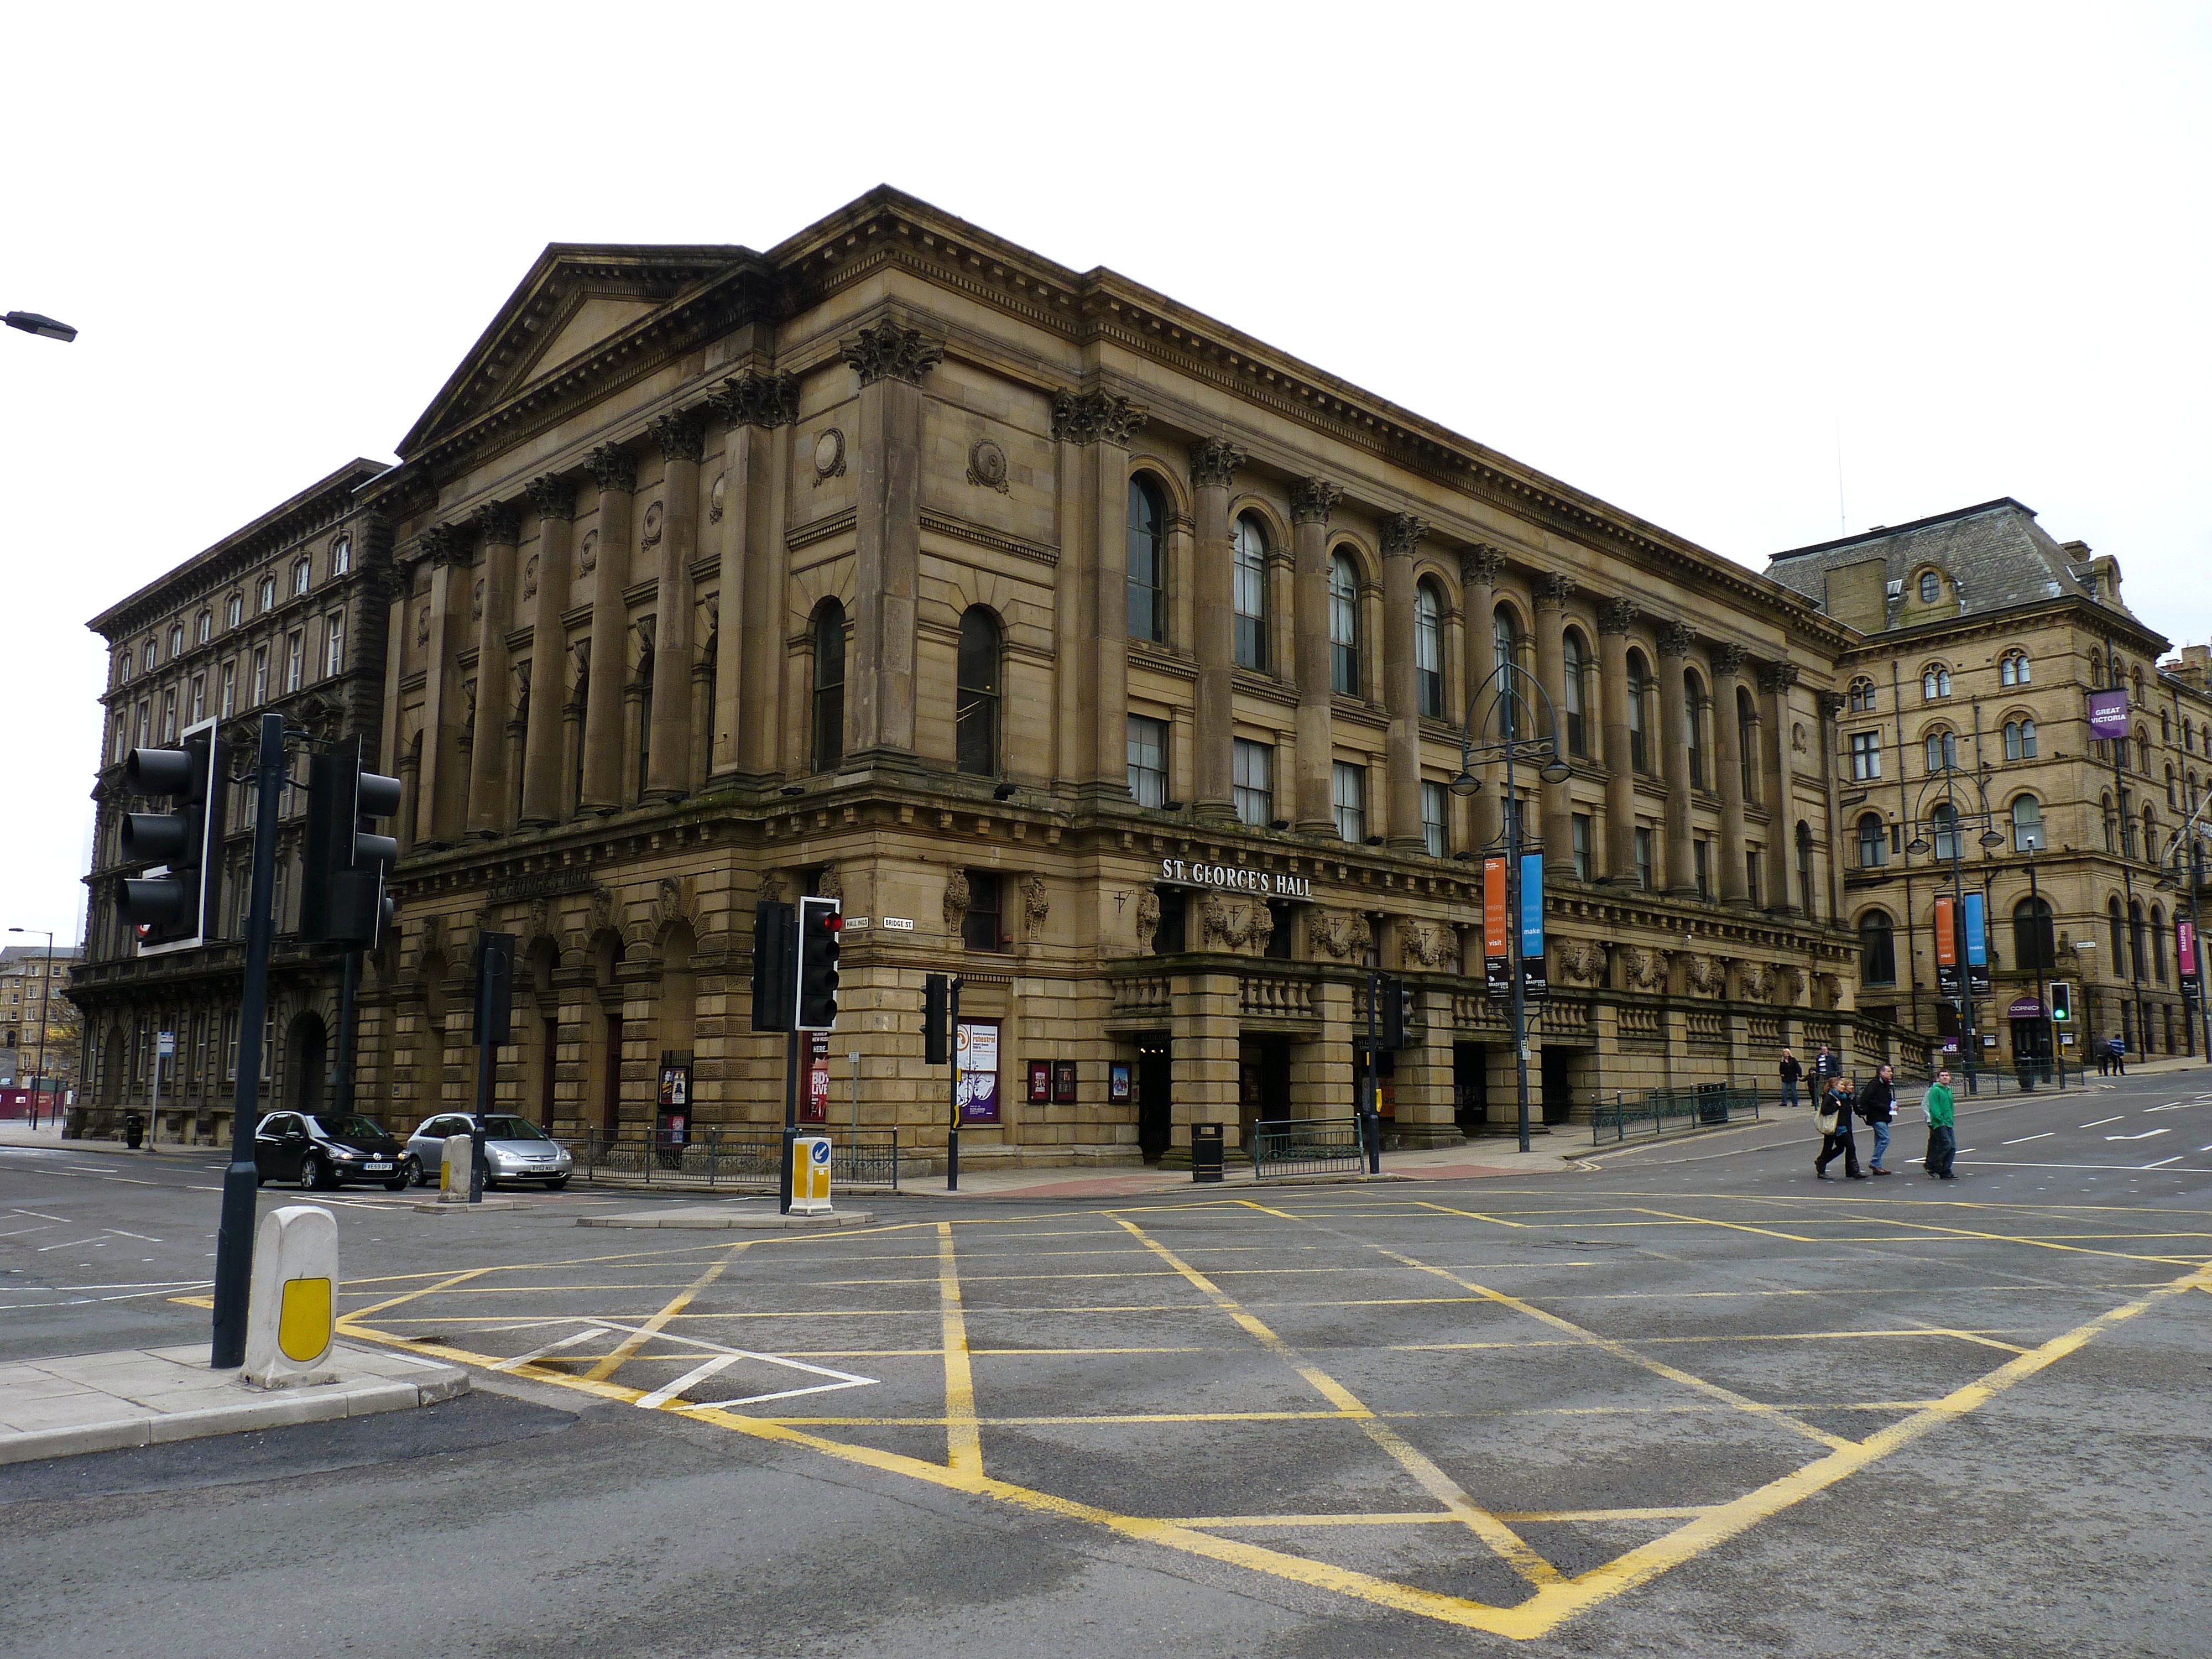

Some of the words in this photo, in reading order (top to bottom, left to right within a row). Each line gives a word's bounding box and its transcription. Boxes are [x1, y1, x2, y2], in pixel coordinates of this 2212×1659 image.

[2095, 707, 2120, 716] GREAT
[2091, 714, 2126, 724] VICTORIA
[1163, 859, 1187, 880] ST.
[1193, 863, 1269, 891] GEORGE'S
[1276, 875, 1312, 896] HALL
